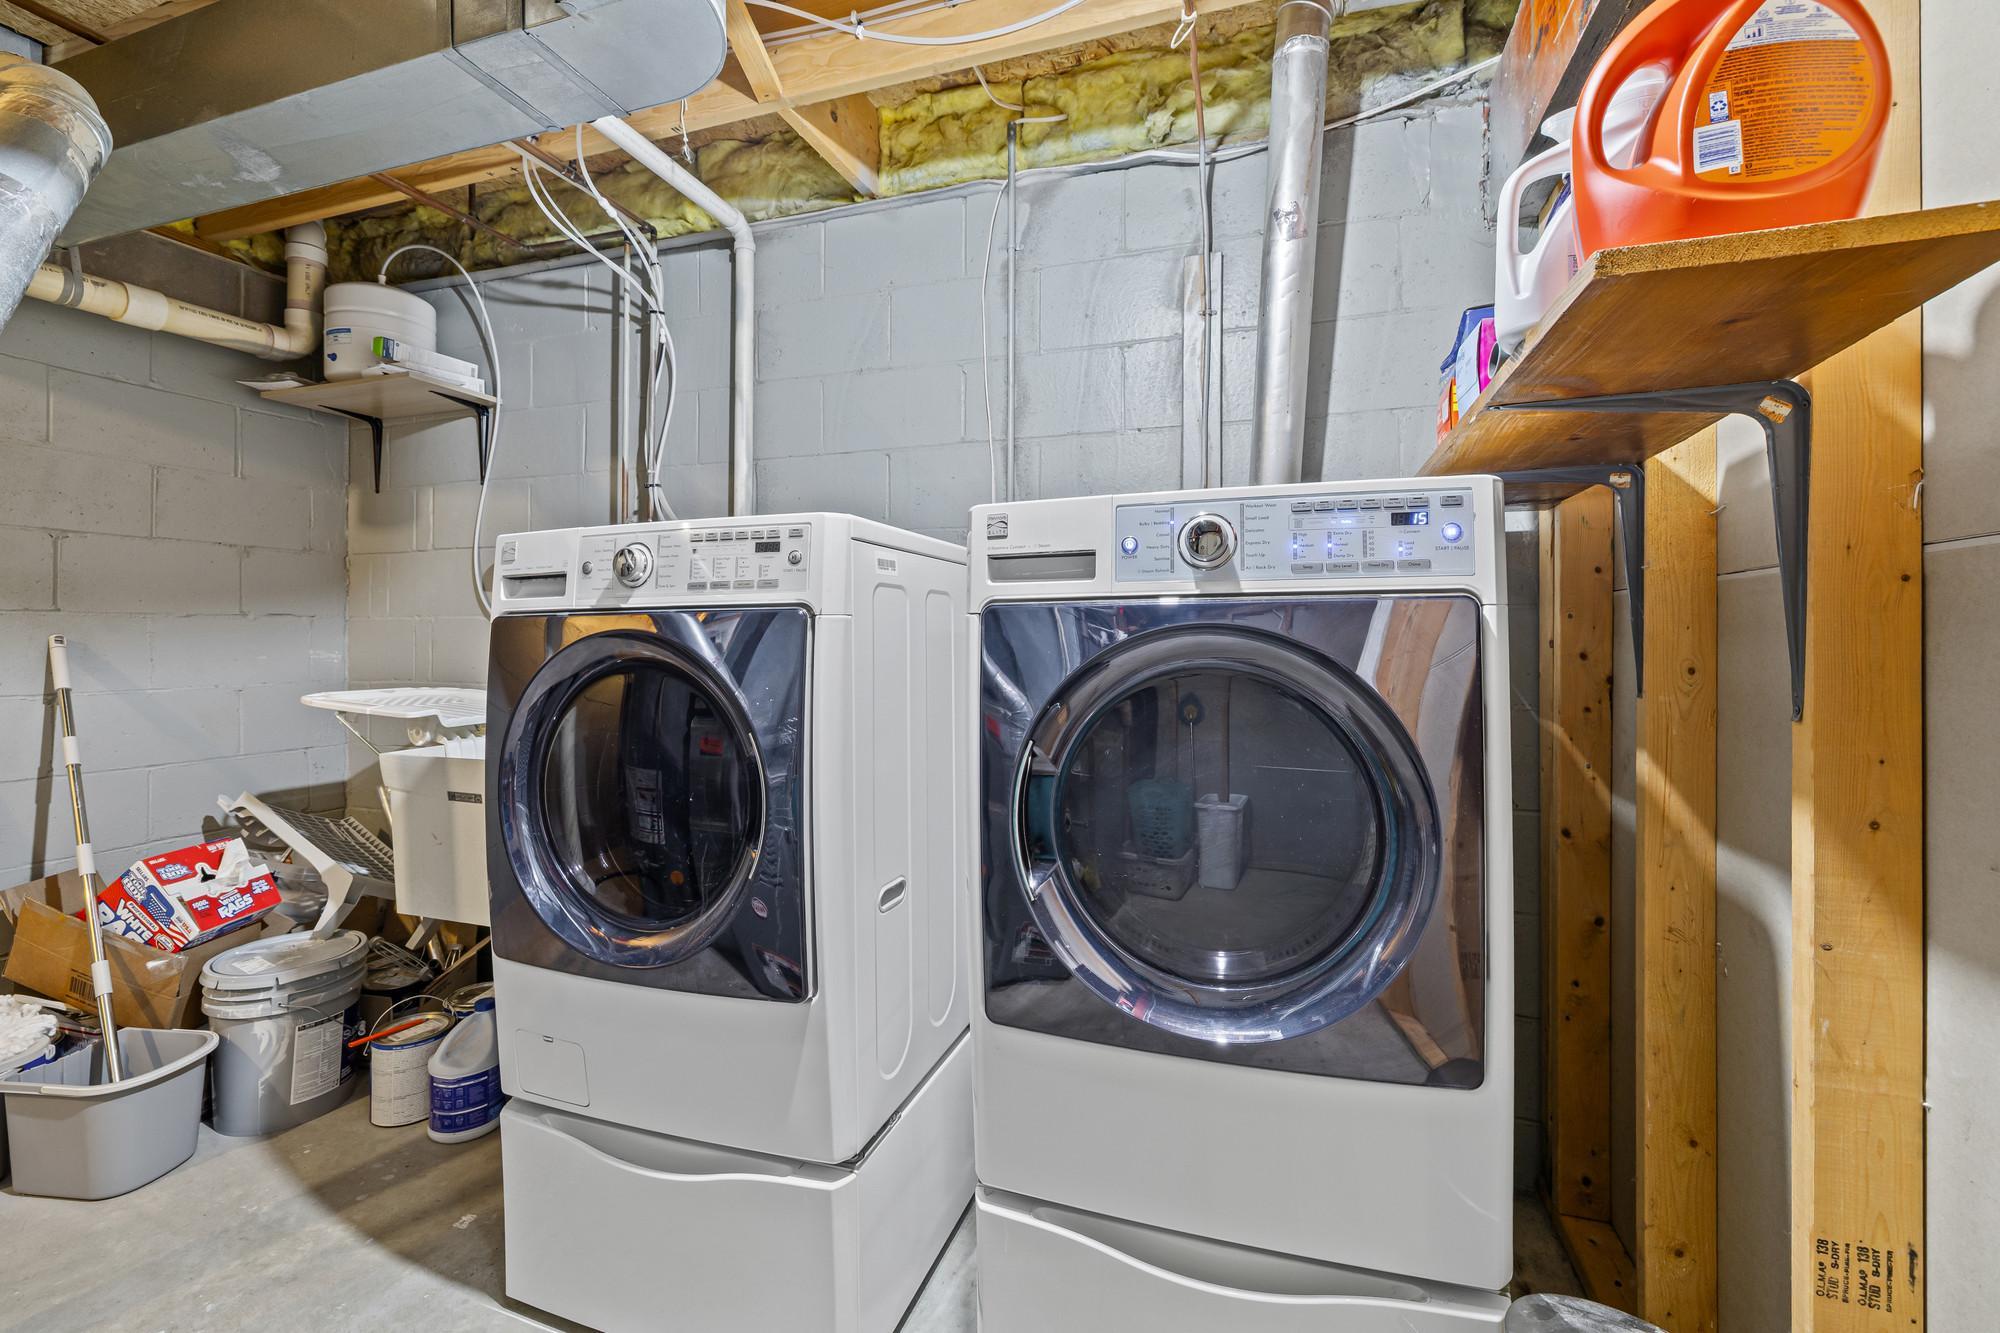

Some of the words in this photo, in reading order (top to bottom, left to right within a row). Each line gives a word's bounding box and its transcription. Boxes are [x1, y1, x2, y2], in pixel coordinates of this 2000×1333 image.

[1413, 512, 1428, 524] 15
[122, 878, 146, 904] BOX
[116, 898, 154, 940] WHITE
[129, 902, 157, 931] PROFESSIONAL
[217, 894, 253, 918] RAGS
[1816, 1238, 1829, 1255] 138
[1831, 1241, 1840, 1270] S-DRY
[1856, 1246, 1870, 1263] 138
[1872, 1248, 1881, 1278] S-DRY
[1826, 1276, 1839, 1300] STUD
[1868, 1285, 1881, 1311] STUD
